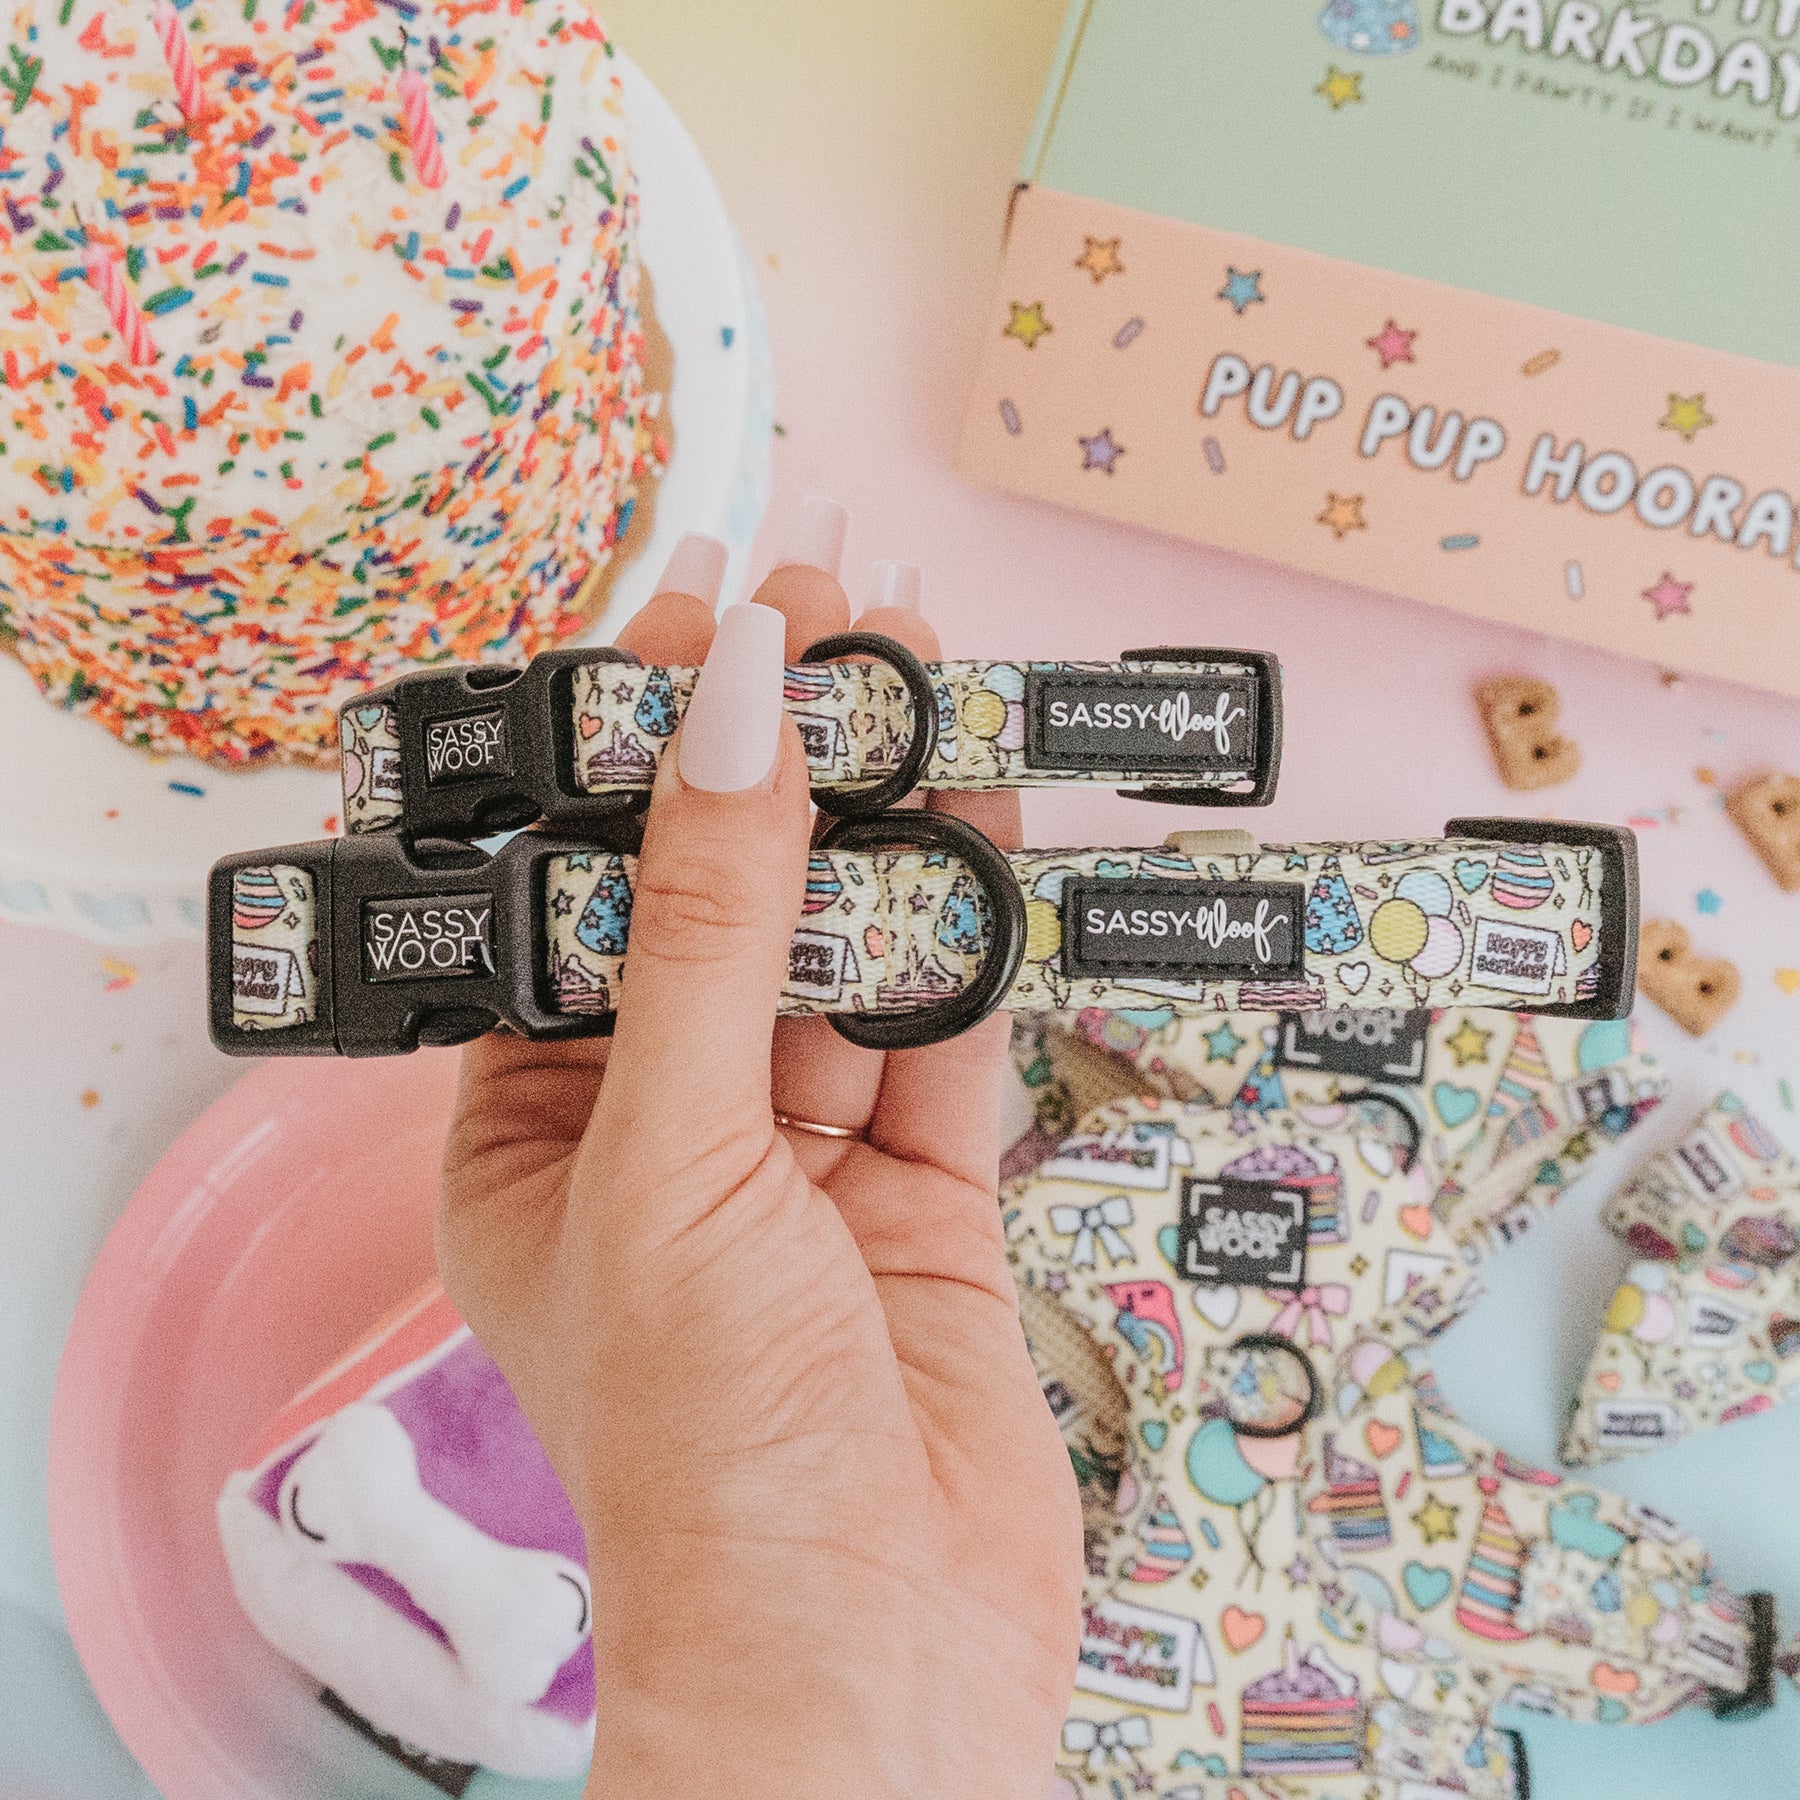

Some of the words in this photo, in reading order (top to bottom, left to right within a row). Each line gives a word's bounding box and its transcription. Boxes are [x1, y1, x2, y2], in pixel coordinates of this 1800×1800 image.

[1200, 353, 1343, 441] PUP
[1360, 394, 1506, 482] PUP
[1522, 432, 1800, 571] HOORA
[430, 720, 503, 751] SASSY
[427, 740, 500, 773] WOOF
[375, 908, 490, 941] SASSY
[366, 936, 483, 970] WOOF
